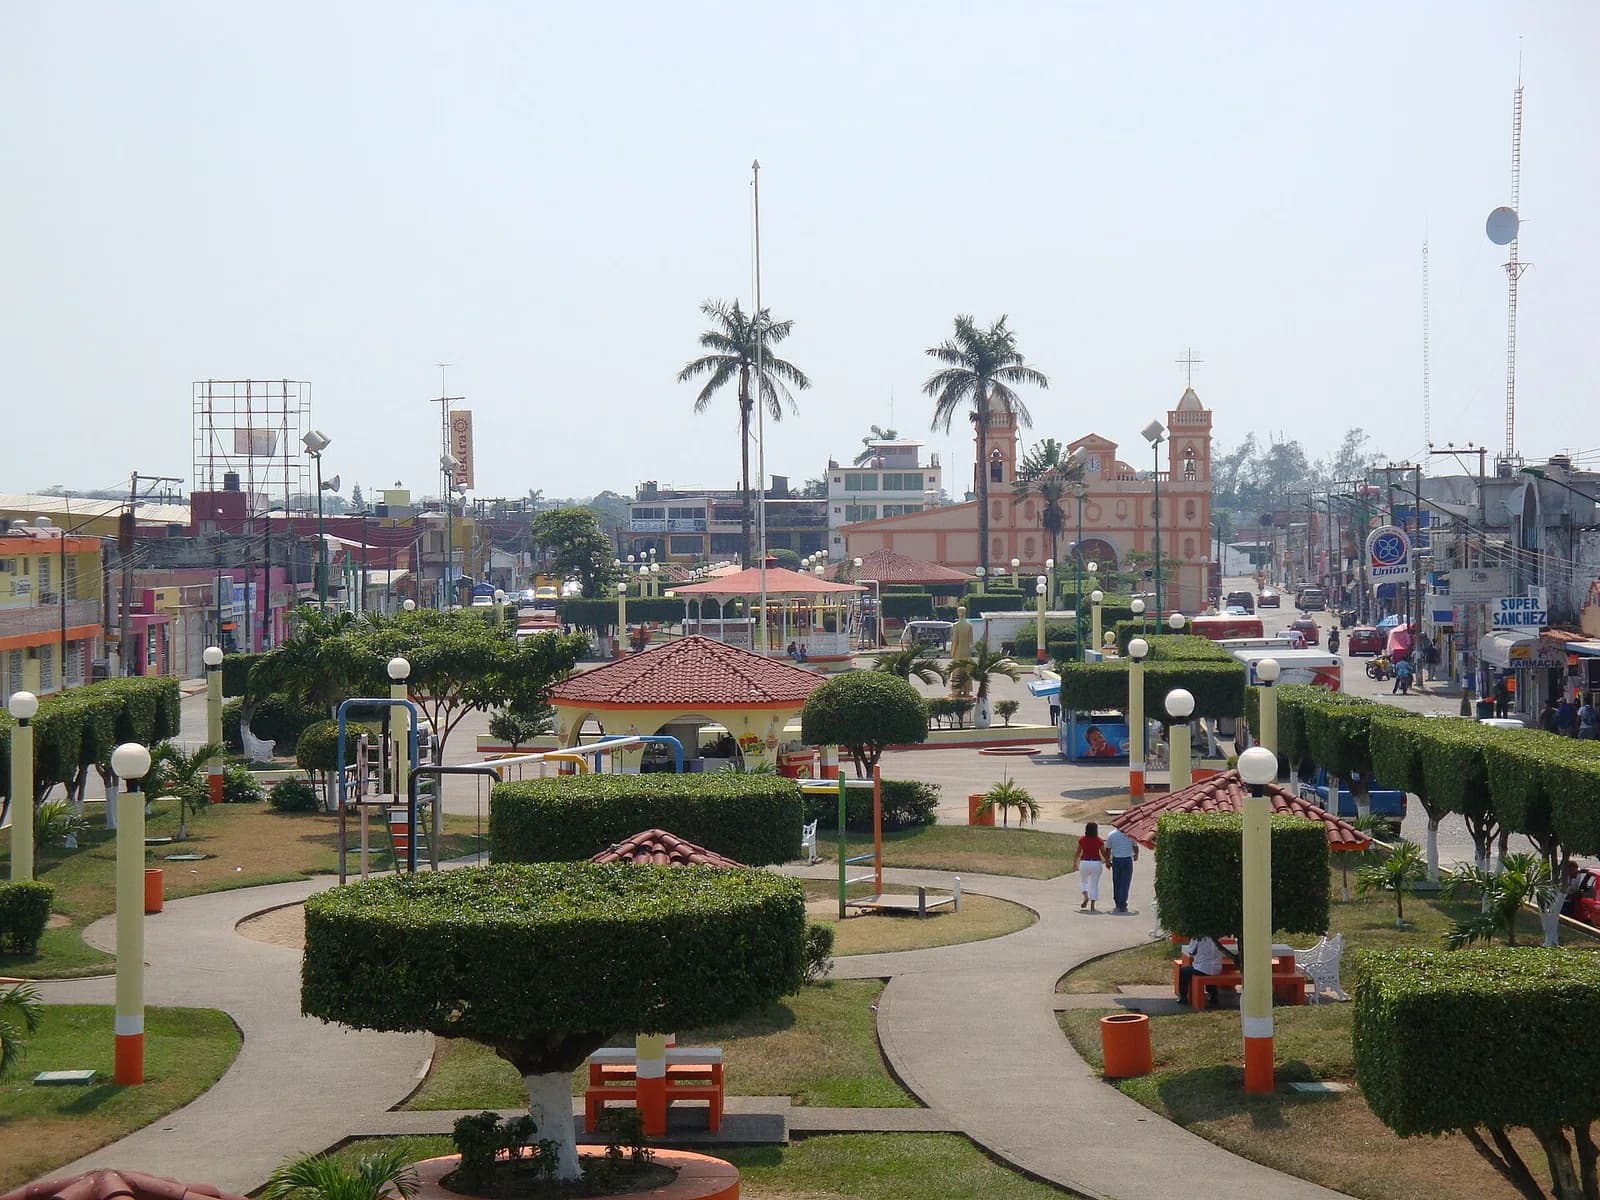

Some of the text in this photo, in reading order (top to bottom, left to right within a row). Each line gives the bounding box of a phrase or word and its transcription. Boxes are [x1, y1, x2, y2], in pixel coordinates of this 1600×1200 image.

[455, 432, 468, 485] Elektra
[1372, 566, 1409, 576] Unión
[1501, 598, 1540, 610] SUPER
[1493, 611, 1547, 625] SANCHEZ
[1509, 659, 1562, 668] FARMACIA
